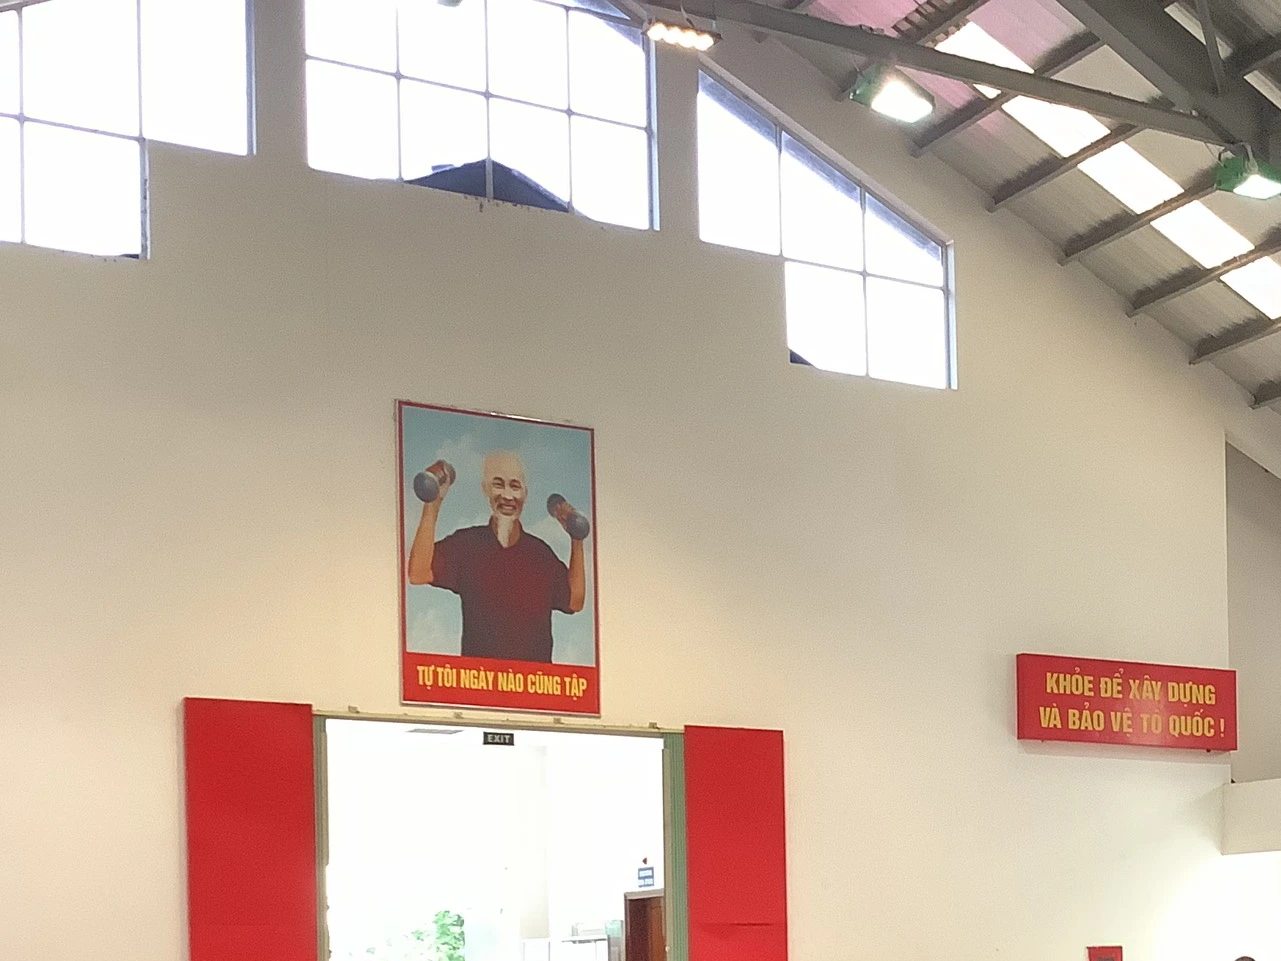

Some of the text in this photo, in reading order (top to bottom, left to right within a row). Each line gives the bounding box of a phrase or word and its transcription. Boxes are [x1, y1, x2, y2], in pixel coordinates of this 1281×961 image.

[417, 664, 587, 700] TỰ TÔI NGÀY NÀO CŨNG TẬP
[1046, 667, 1216, 707] KHỎE ĐỂ XÂY DỰNG
[1039, 702, 1062, 729] VÀ
[1068, 702, 1105, 731] BẢO
[1110, 707, 1134, 737] VỆ
[1168, 708, 1215, 738] QUỐC
[487, 734, 511, 743] EXIT
